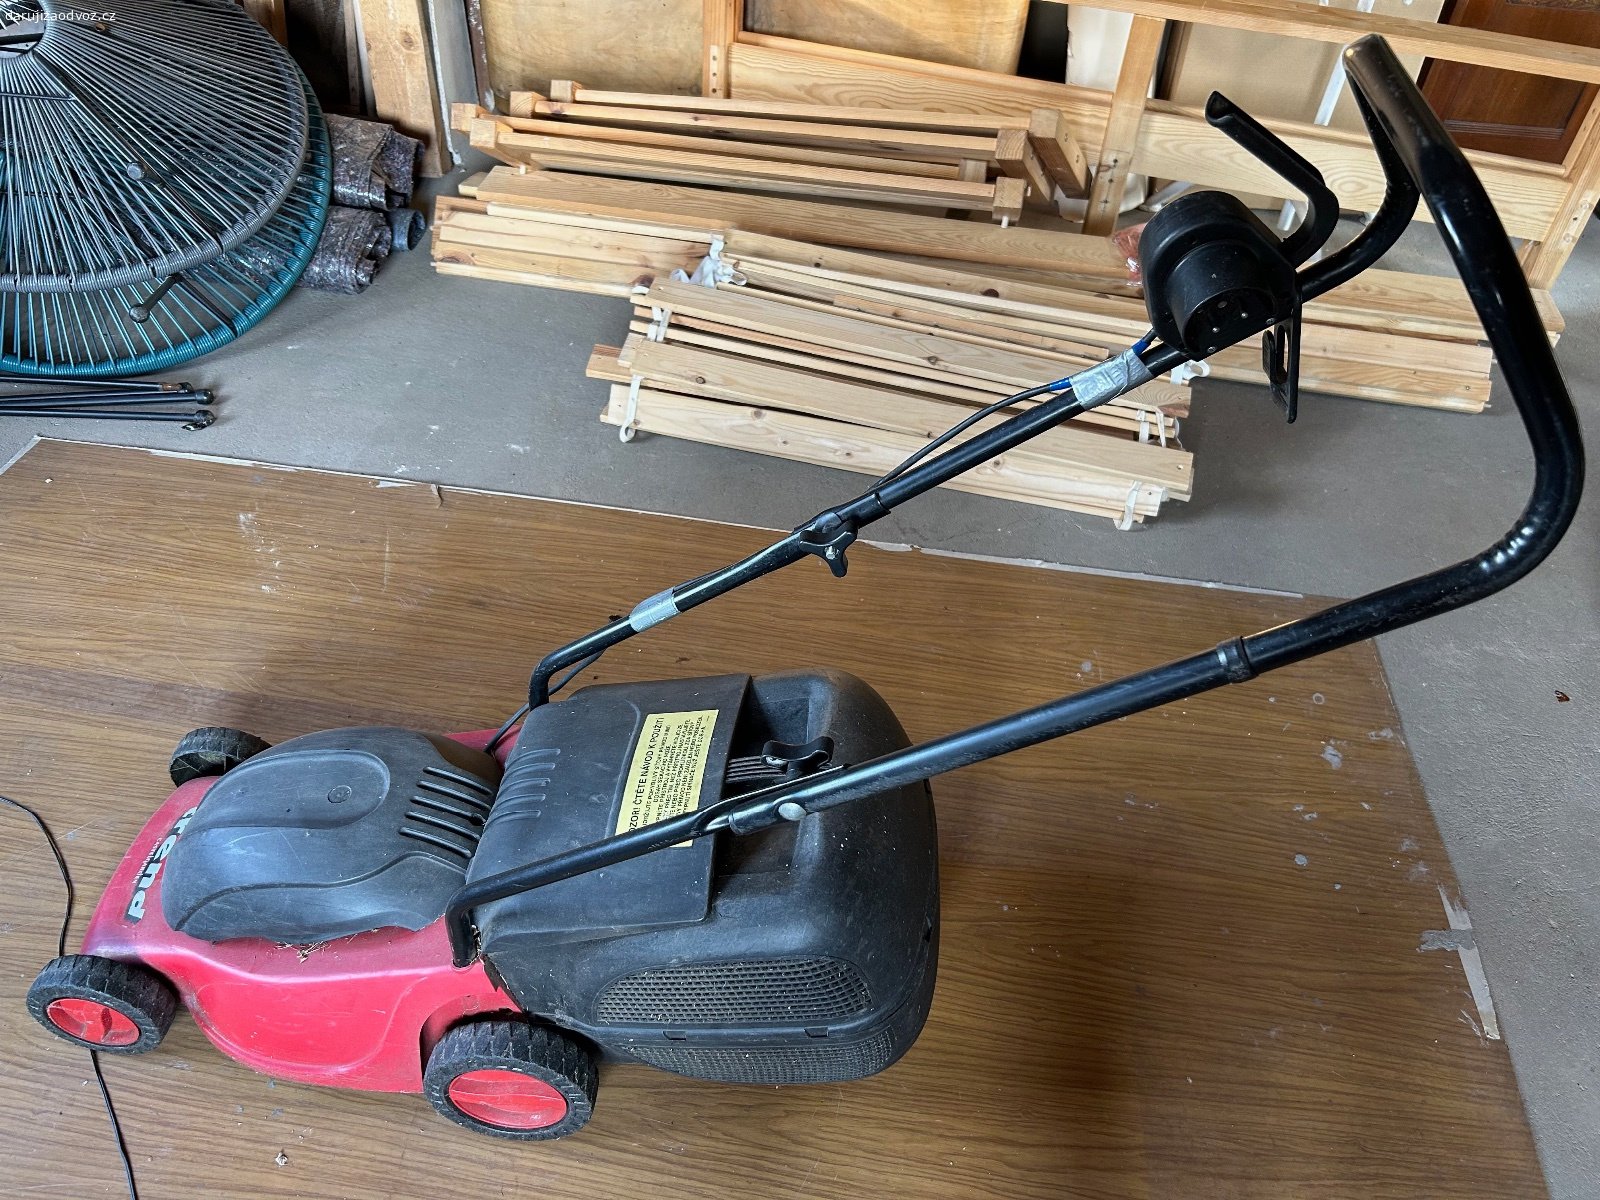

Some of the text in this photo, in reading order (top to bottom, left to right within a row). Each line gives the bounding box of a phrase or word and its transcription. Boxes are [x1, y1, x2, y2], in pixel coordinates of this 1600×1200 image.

[650, 717, 664, 742] POUŽITÍ
[640, 751, 654, 776] NÁVOD
[632, 777, 648, 805] ČTĚTE
[629, 807, 641, 831] OZOR!
[127, 806, 198, 920] trend
